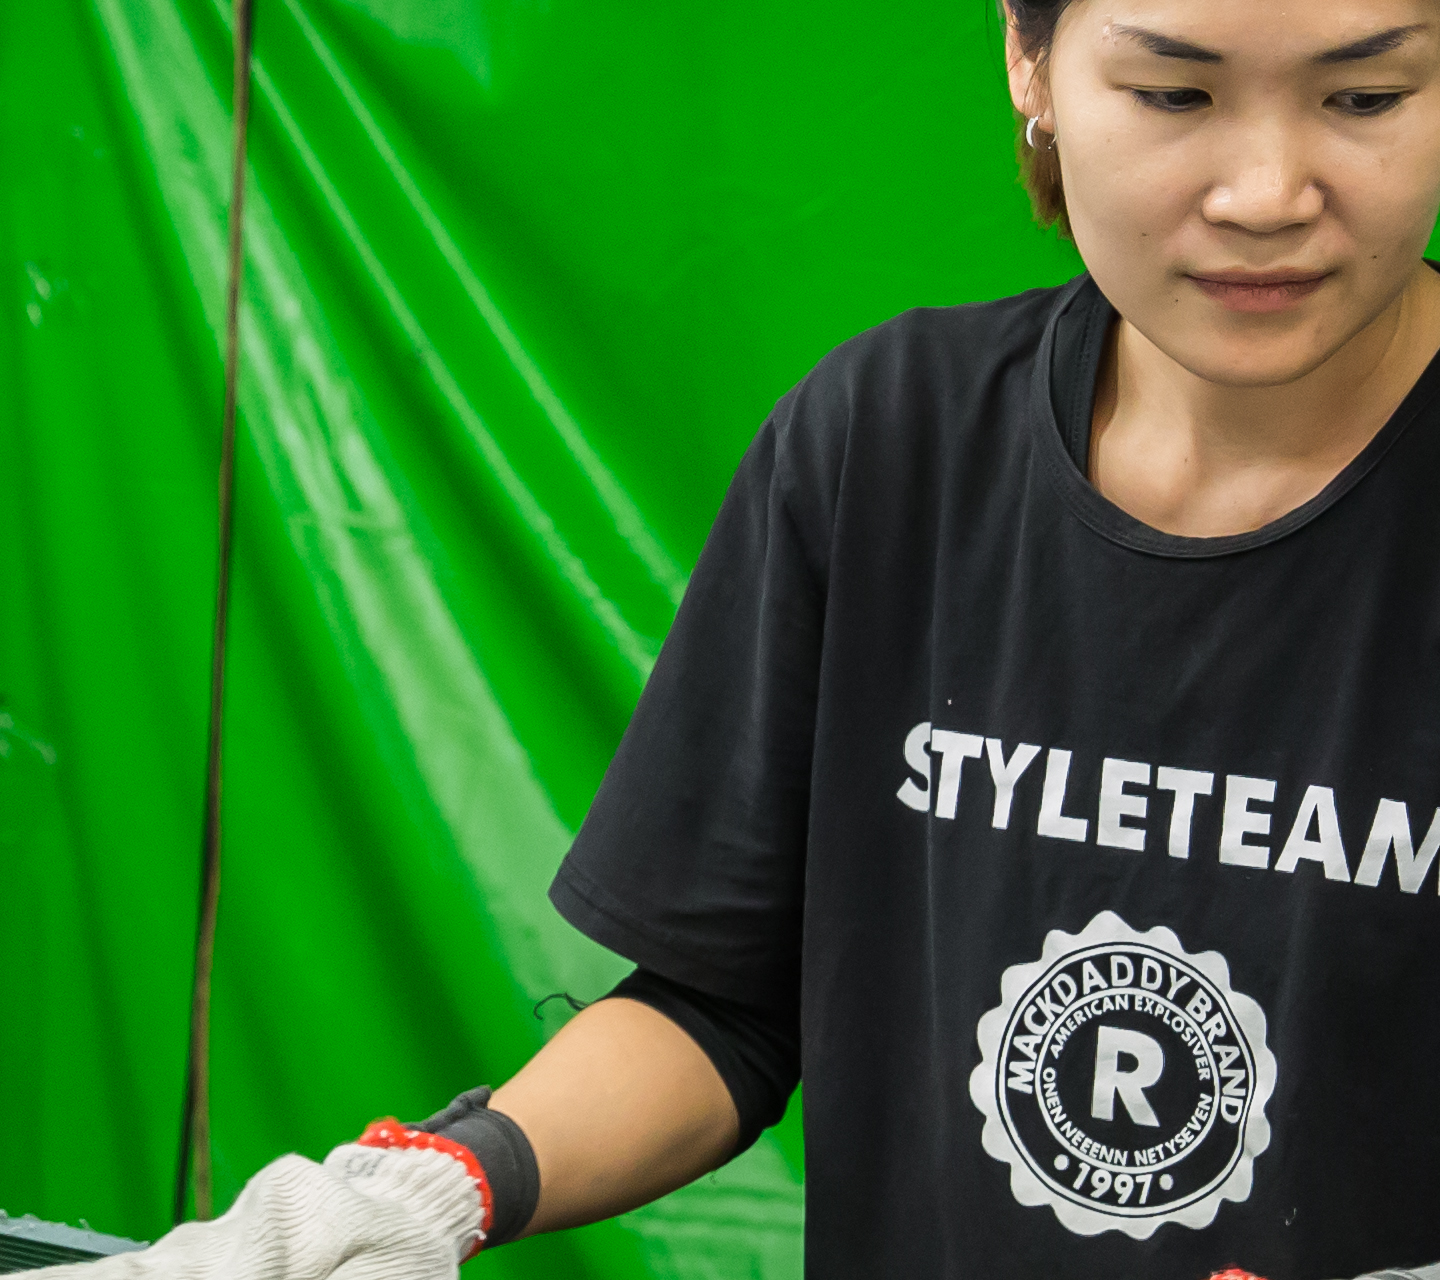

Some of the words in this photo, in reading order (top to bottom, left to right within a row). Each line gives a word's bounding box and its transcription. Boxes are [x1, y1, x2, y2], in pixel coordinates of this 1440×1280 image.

[1049, 994, 1130, 1060] AMERICAN
[1184, 987, 1248, 1124] BRAND
[1091, 1025, 1165, 1128] R
[1072, 1161, 1153, 1205] 1997
